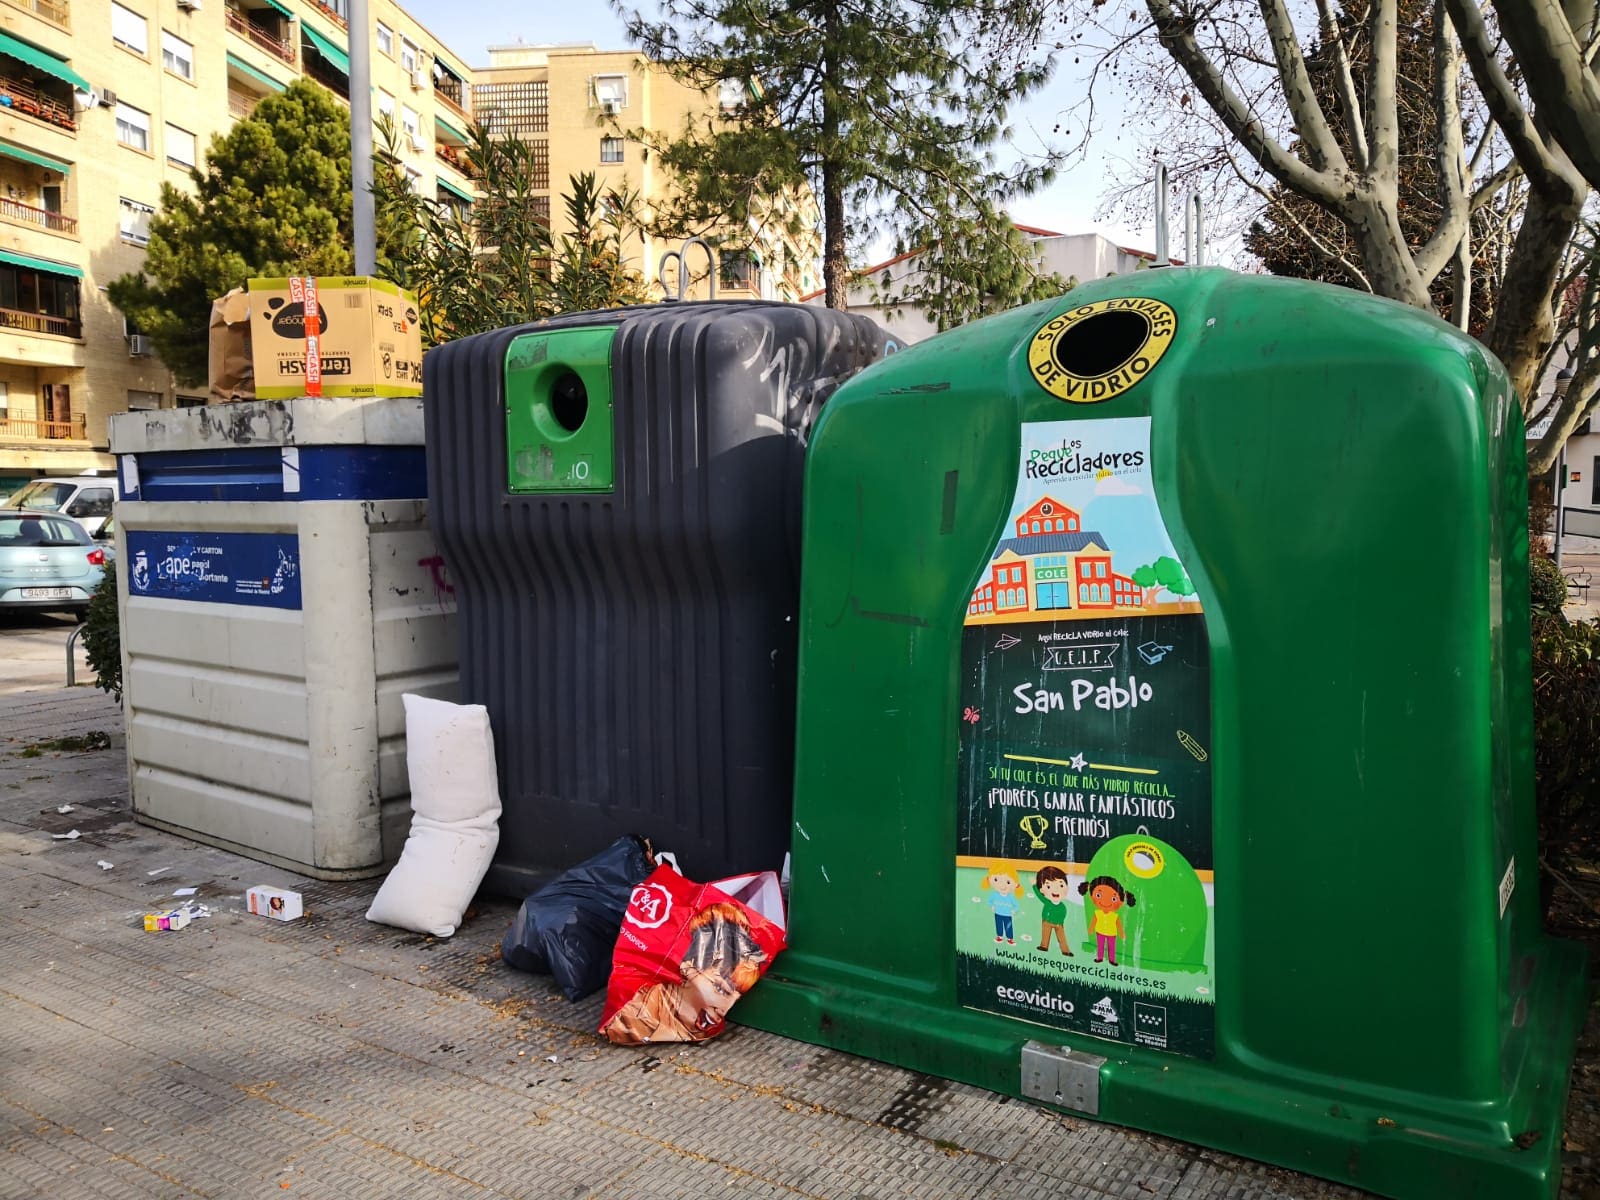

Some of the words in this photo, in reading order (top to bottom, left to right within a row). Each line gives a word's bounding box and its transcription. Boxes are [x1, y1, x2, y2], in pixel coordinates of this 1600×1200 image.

[1037, 305, 1095, 342] SOLO
[1105, 298, 1172, 338] ENVASES
[279, 358, 350, 375] ferrASH
[1035, 359, 1062, 386] DE
[1065, 356, 1150, 399] VIDRIO
[1030, 447, 1072, 464] Peque
[1063, 438, 1082, 451] Los
[1026, 451, 1145, 479] Recicladores
[1037, 569, 1067, 579] COLE
[1055, 649, 1107, 665] C.E.I.P.
[1013, 682, 1064, 714] San
[1070, 675, 1153, 711] Pablo
[988, 766, 997, 779] SI
[1013, 769, 1032, 783] COLE
[1049, 772, 1058, 786] EL
[1063, 774, 1079, 788] QUE
[1103, 777, 1130, 793] VIDRIO
[1044, 791, 1085, 812] GANAR
[1089, 793, 1176, 820] FANTÁSTICOS
[630, 887, 661, 920] C&A
[996, 948, 1167, 990] www.lospequerecicladores.es
[996, 985, 1075, 1013] ecovidrio
[1090, 1028, 1120, 1038] MADRID
